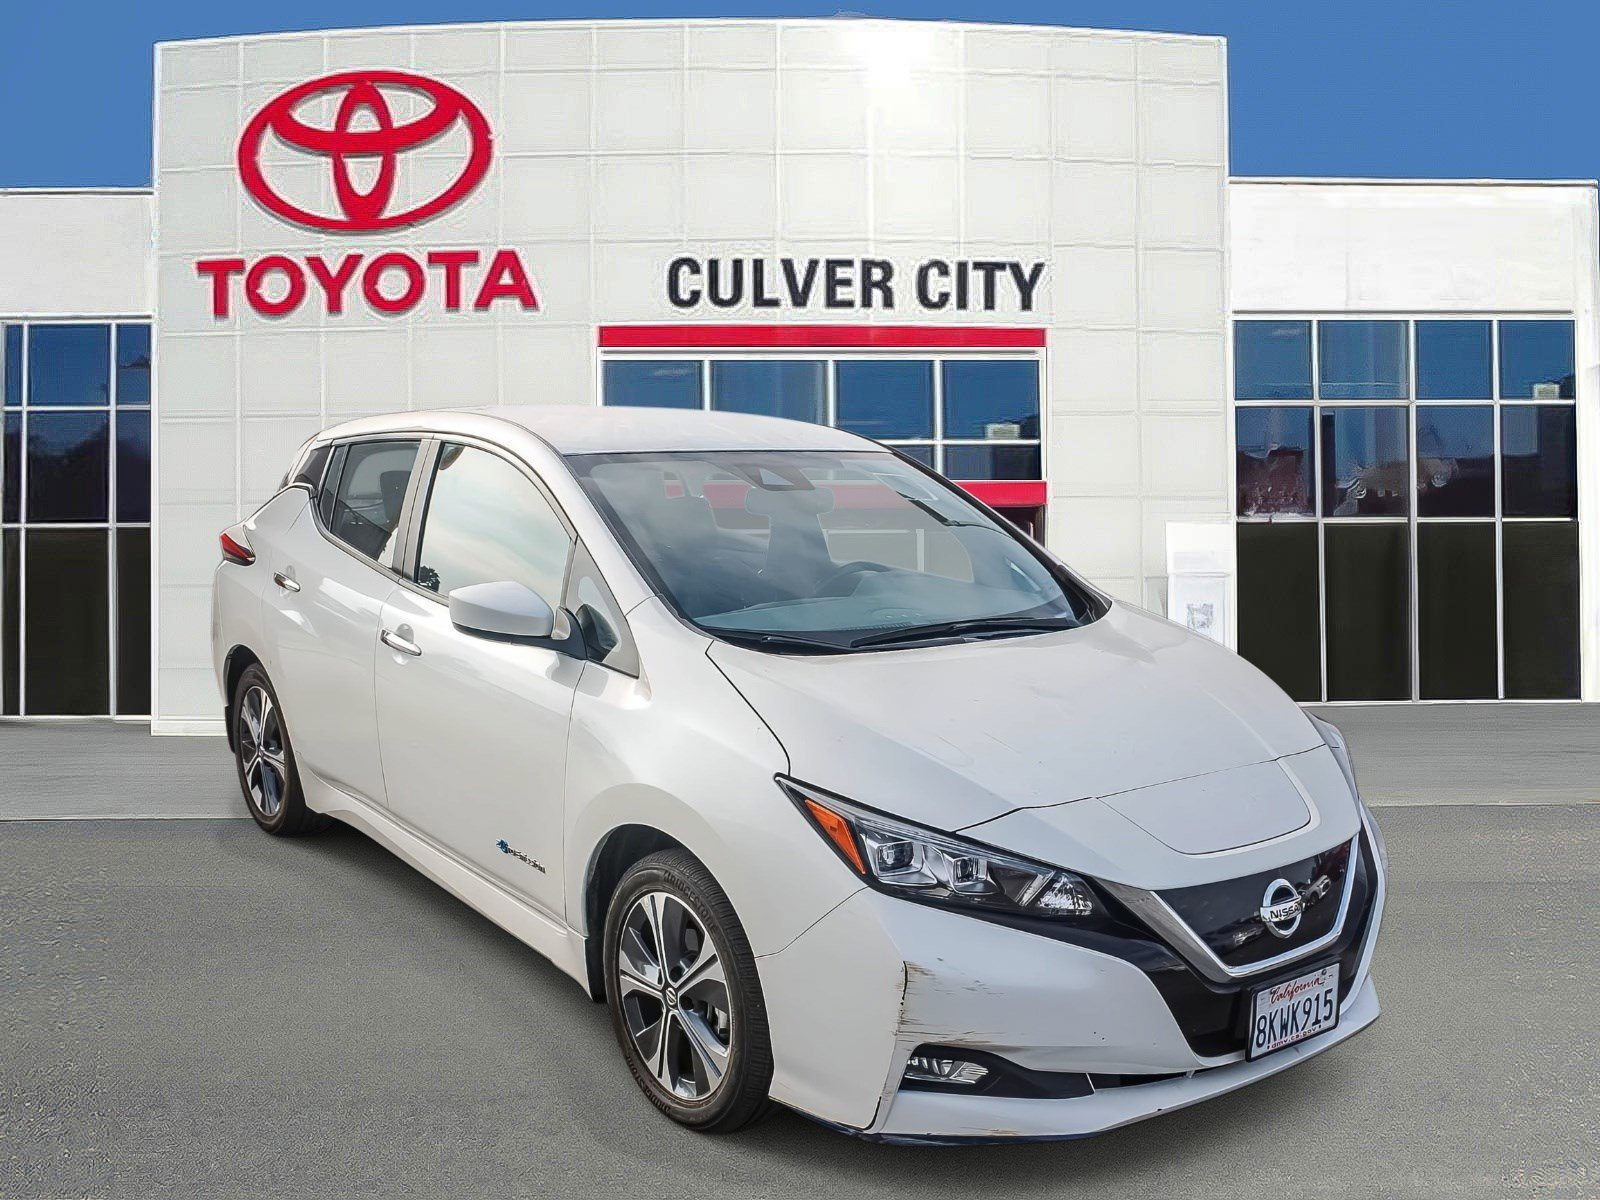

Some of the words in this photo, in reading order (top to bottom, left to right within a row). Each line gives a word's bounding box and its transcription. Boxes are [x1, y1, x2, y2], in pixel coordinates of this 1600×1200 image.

[197, 250, 538, 317] TOYOTA
[668, 257, 894, 308] CULVER
[918, 260, 1045, 310] CITY
[1270, 977, 1324, 1004] California
[1256, 988, 1333, 1048] 8KWK915
[1271, 1026, 1317, 1048] dmv.ca.gov
